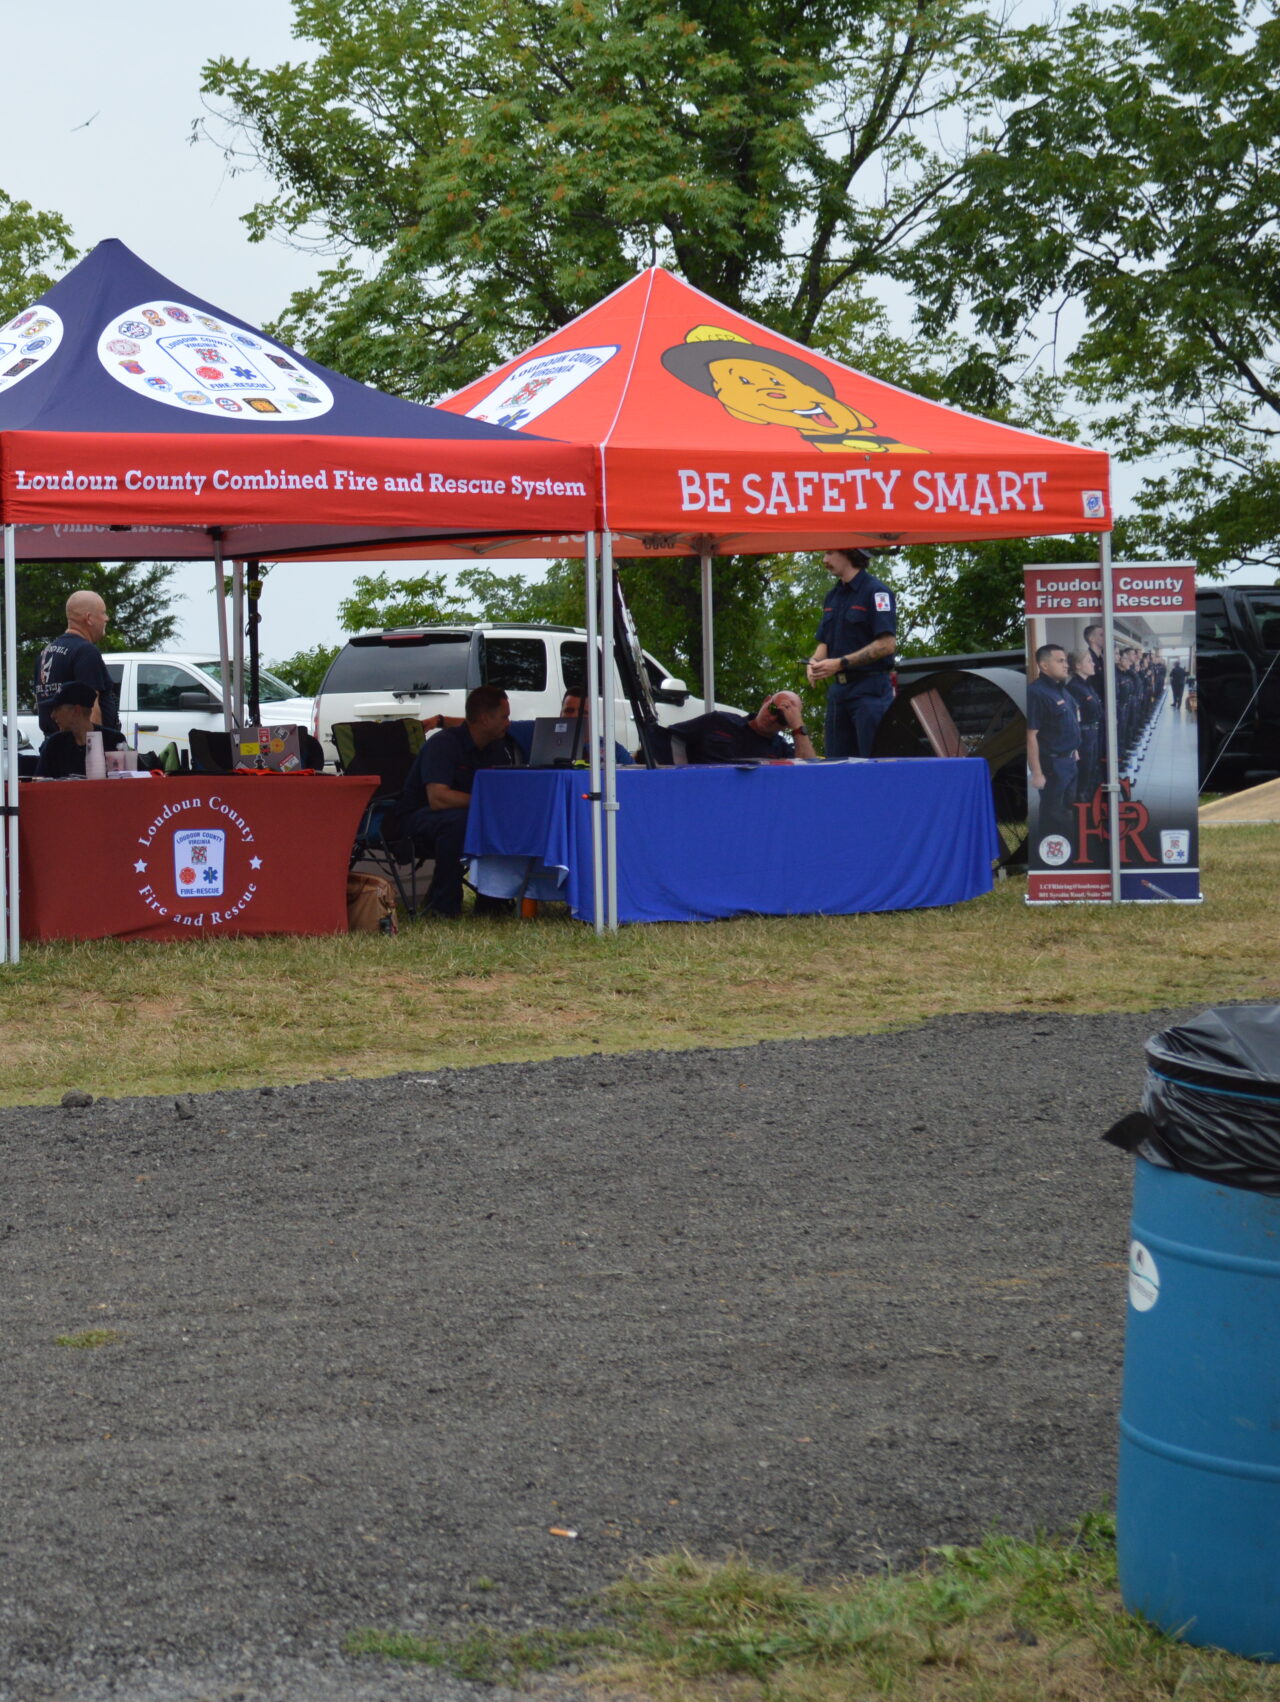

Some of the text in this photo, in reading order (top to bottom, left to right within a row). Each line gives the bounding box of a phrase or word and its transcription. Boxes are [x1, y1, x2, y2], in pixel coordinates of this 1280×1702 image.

[510, 352, 604, 381] LOUDOUN COUNTY
[530, 364, 576, 378] VIRGINIA
[15, 469, 586, 501] Loudoun County Combined Fire and Rescue System
[678, 469, 731, 513] BE
[742, 468, 901, 516] SAFETY
[912, 470, 1047, 516] SMART
[1036, 577, 1184, 593] Loudou County
[1036, 594, 1184, 609] Fire an Rescue
[138, 796, 255, 847] Loudoun County
[176, 832, 223, 844] LOUDOUN COUNTY
[138, 882, 257, 927] Fire and Rescue
